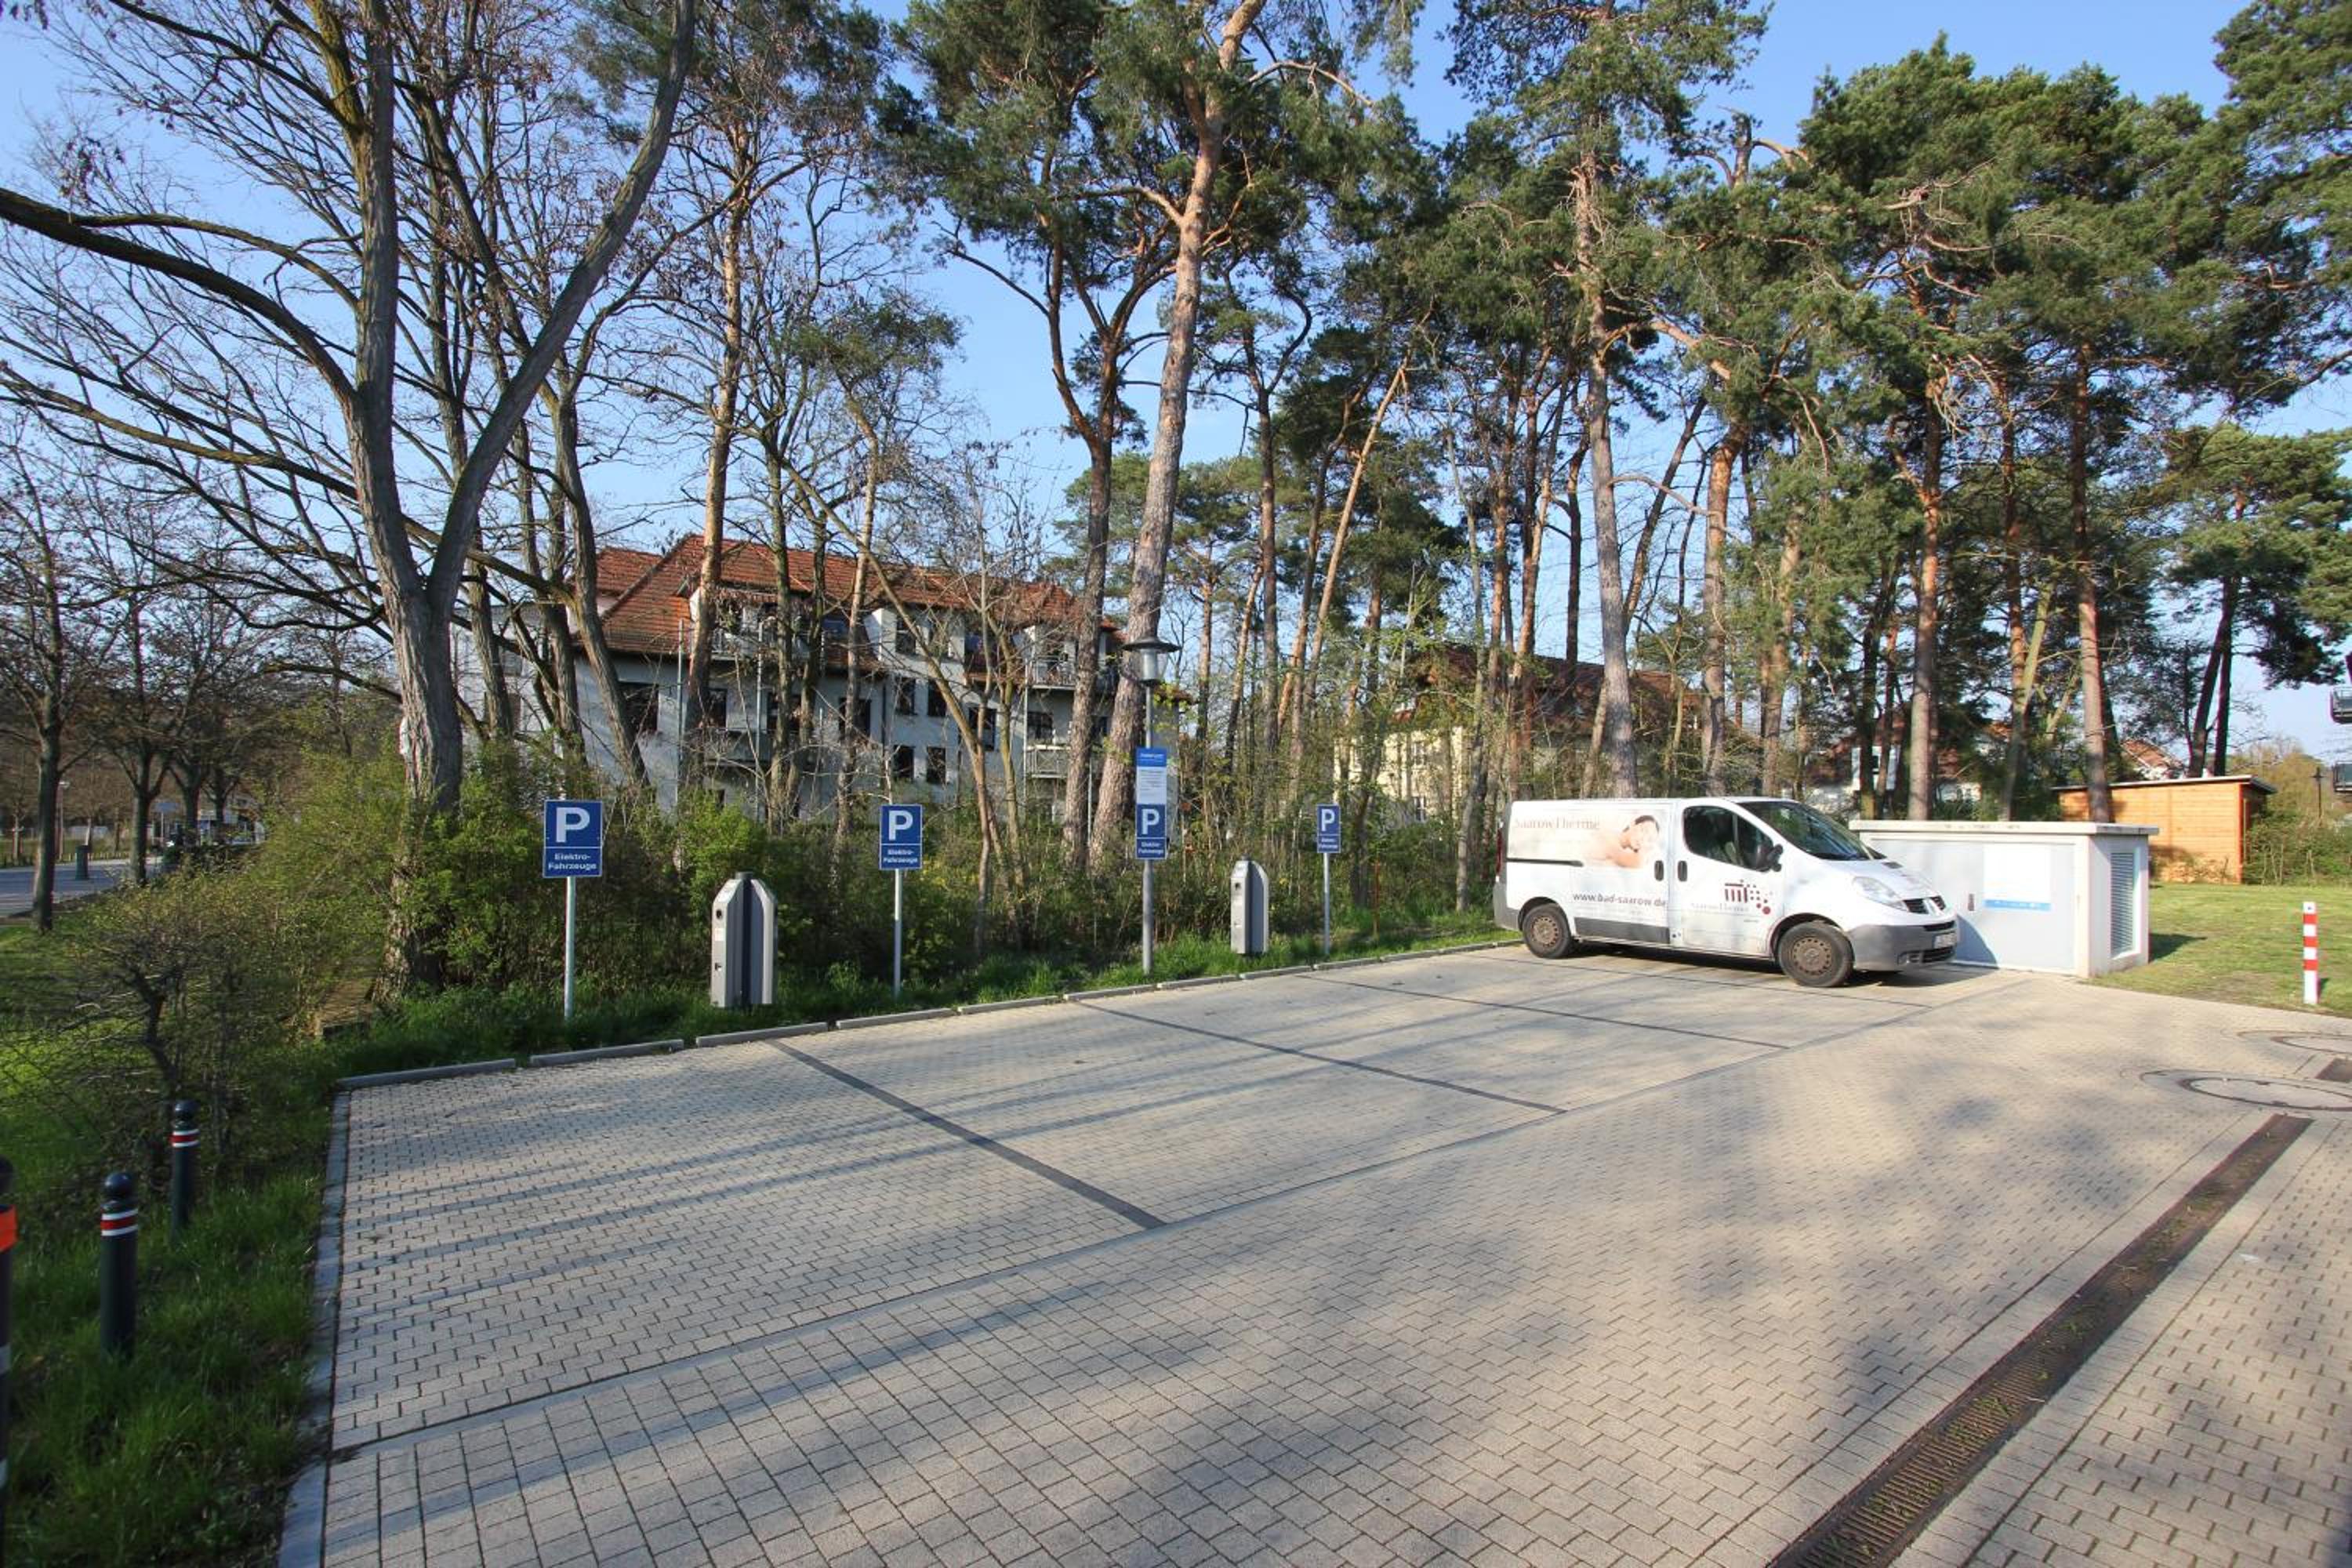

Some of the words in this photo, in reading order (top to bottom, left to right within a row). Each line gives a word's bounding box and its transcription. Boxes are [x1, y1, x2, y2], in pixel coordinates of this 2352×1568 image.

[556, 807, 590, 843] P
[888, 810, 913, 840] P
[1142, 808, 1160, 835] P
[1321, 808, 1335, 832] P
[548, 862, 597, 871] Fahrzeuge
